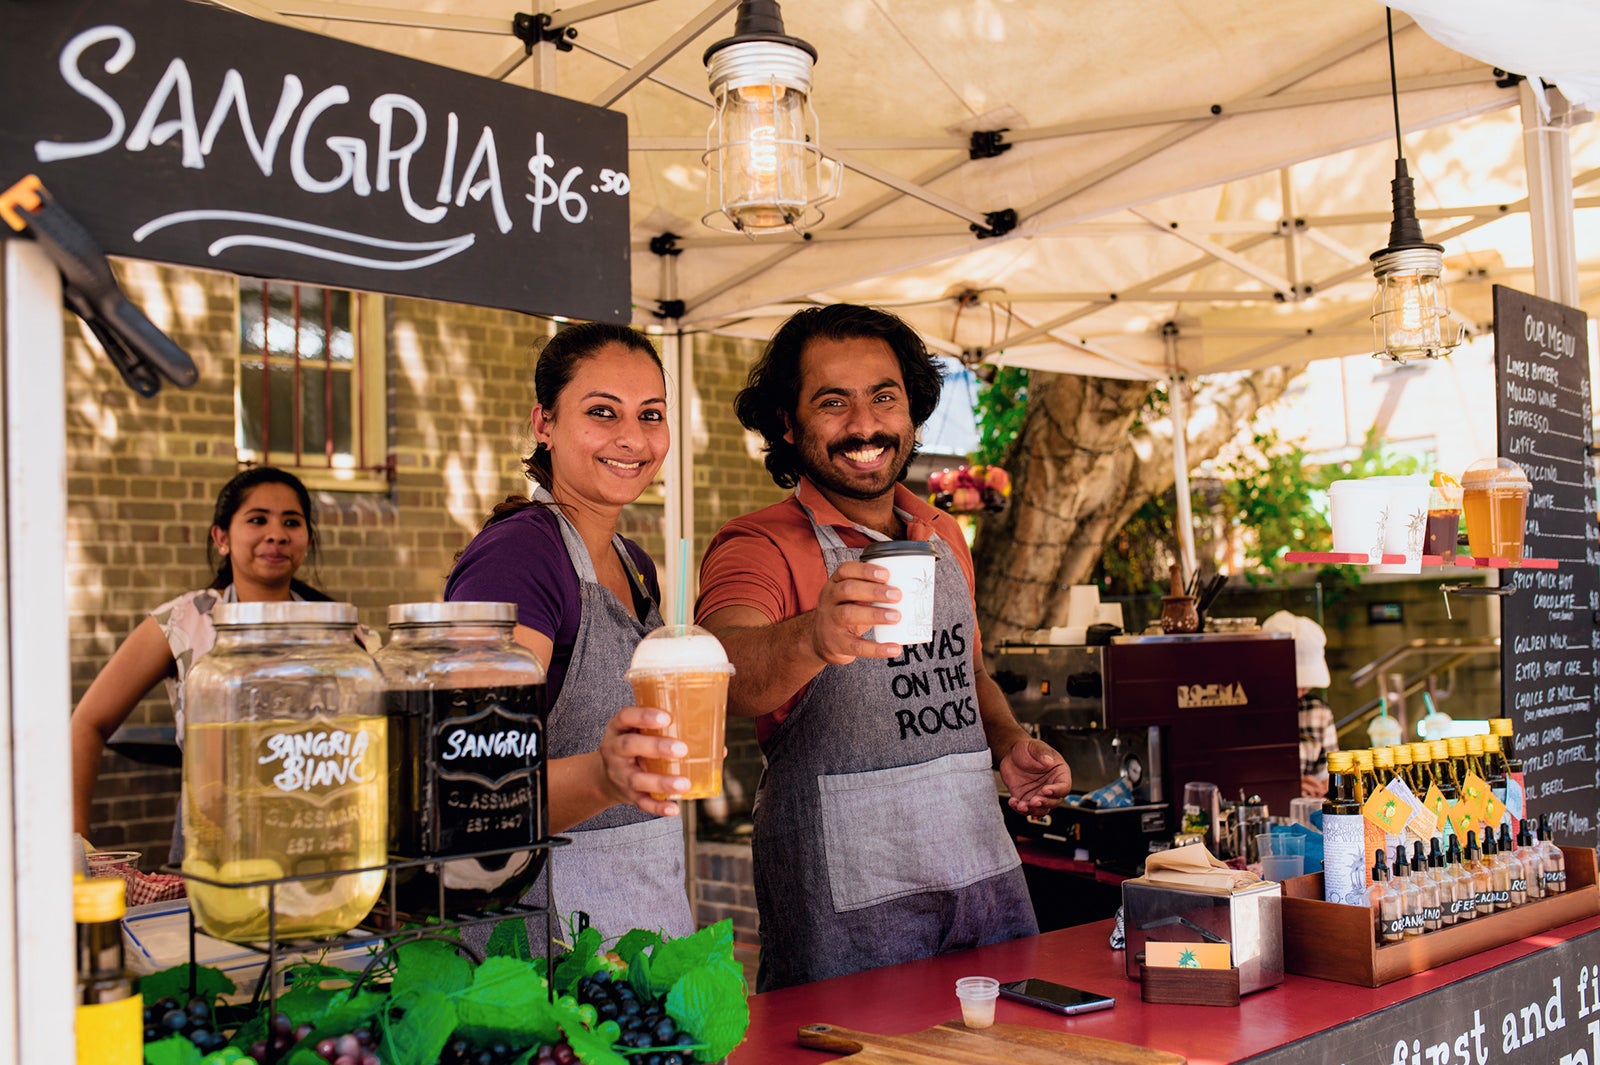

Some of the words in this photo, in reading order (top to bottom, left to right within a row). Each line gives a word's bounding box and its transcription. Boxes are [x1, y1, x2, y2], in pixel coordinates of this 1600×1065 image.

[34, 25, 513, 234] SANGRIA
[1524, 314, 1547, 348] OUR
[1547, 323, 1576, 359] MENU
[1506, 380, 1537, 405] MULLED
[1508, 407, 1549, 435] EXPRESSO
[1533, 593, 1575, 609] CHOCOLATE
[1514, 634, 1547, 654] GOLDEN
[1549, 631, 1568, 649] MILK
[891, 671, 930, 699] ON
[933, 660, 970, 693] THE
[1515, 661, 1541, 682] EXTRA
[1514, 690, 1543, 710] CHOICE
[895, 695, 977, 740] ROCKS
[258, 729, 370, 765] SANGRIA
[442, 728, 538, 760] SANGRIA
[1522, 749, 1554, 777] OTTLED
[1540, 777, 1564, 799] SEEDS
[1502, 976, 1566, 1054] and
